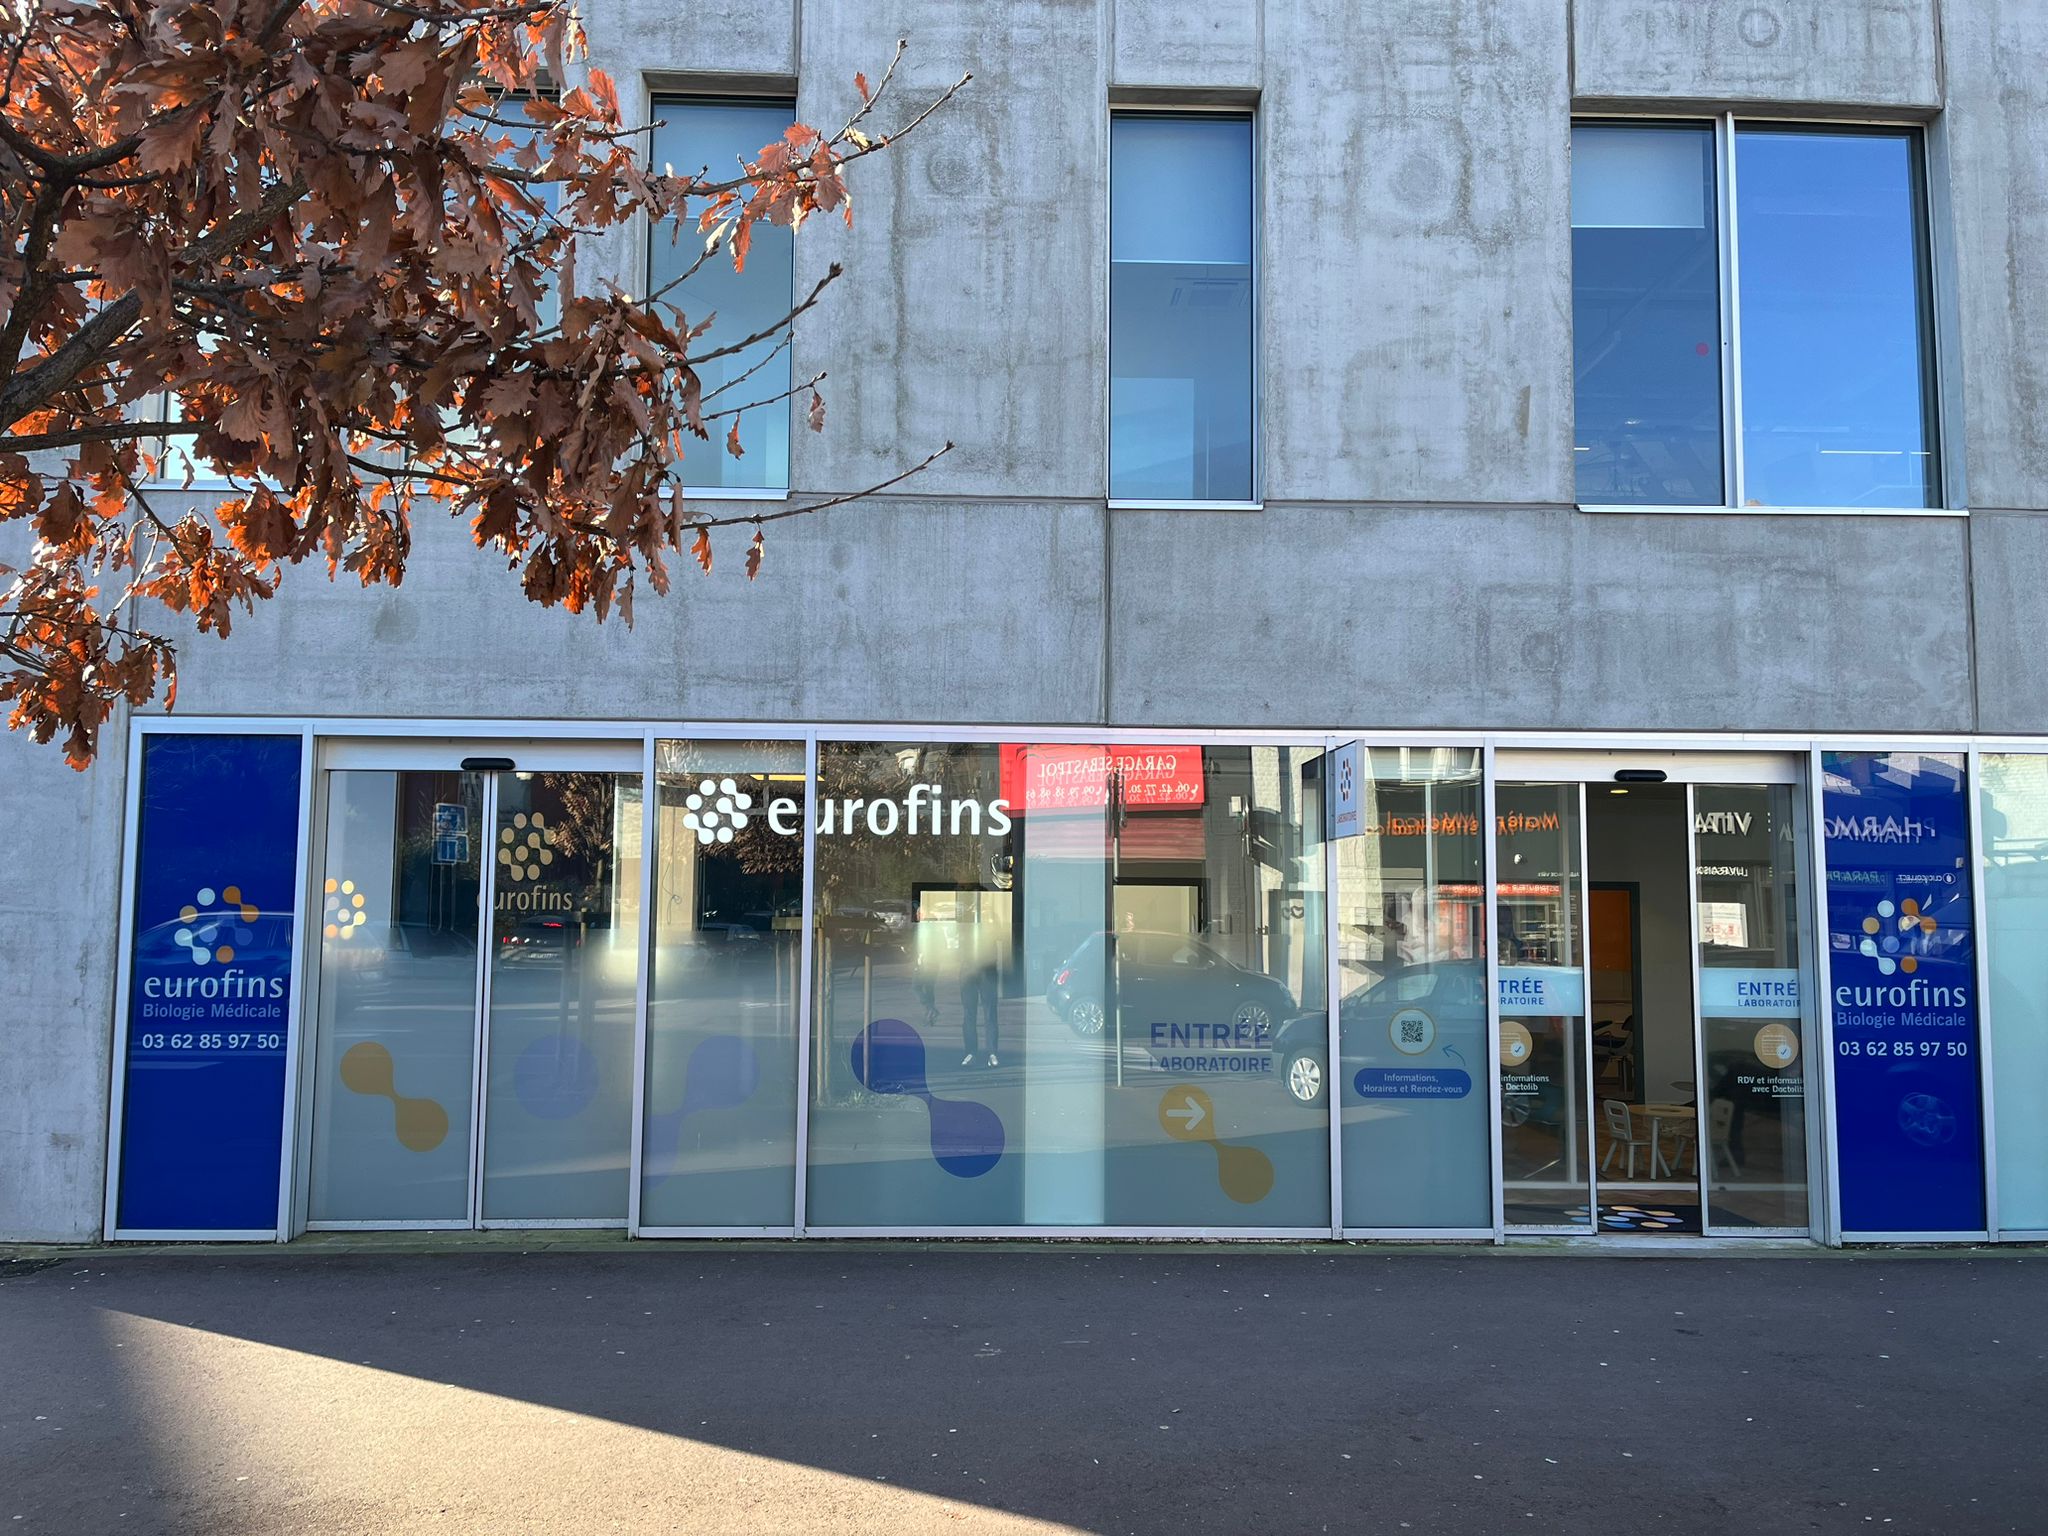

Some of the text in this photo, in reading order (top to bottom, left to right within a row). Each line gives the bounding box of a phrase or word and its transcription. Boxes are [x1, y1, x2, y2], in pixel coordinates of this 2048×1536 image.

[767, 784, 1012, 836] eurofins
[477, 885, 572, 910] urofins
[144, 969, 284, 998] eurofins
[1498, 977, 1544, 994] TRÉE
[1738, 979, 1797, 996] ENTRÉ
[1499, 997, 1545, 1006] RATOIRE
[1836, 979, 1967, 1007] eurofins
[143, 1003, 281, 1021] Biologie Médicale
[1837, 1012, 1966, 1029] Biologie Médicale
[142, 1034, 279, 1049] 03 62 85 97 50
[1151, 1018, 1272, 1049] ENTRÉE
[1839, 1041, 1967, 1057] 03 62 85 97 50
[1384, 1073, 1439, 1083] Informations,
[1737, 1076, 1755, 1084] RDV
[1757, 1076, 1765, 1084] et
[1363, 1084, 1463, 1094] Horaires et Rendez-vous
[1505, 1083, 1538, 1091] Doctolib
